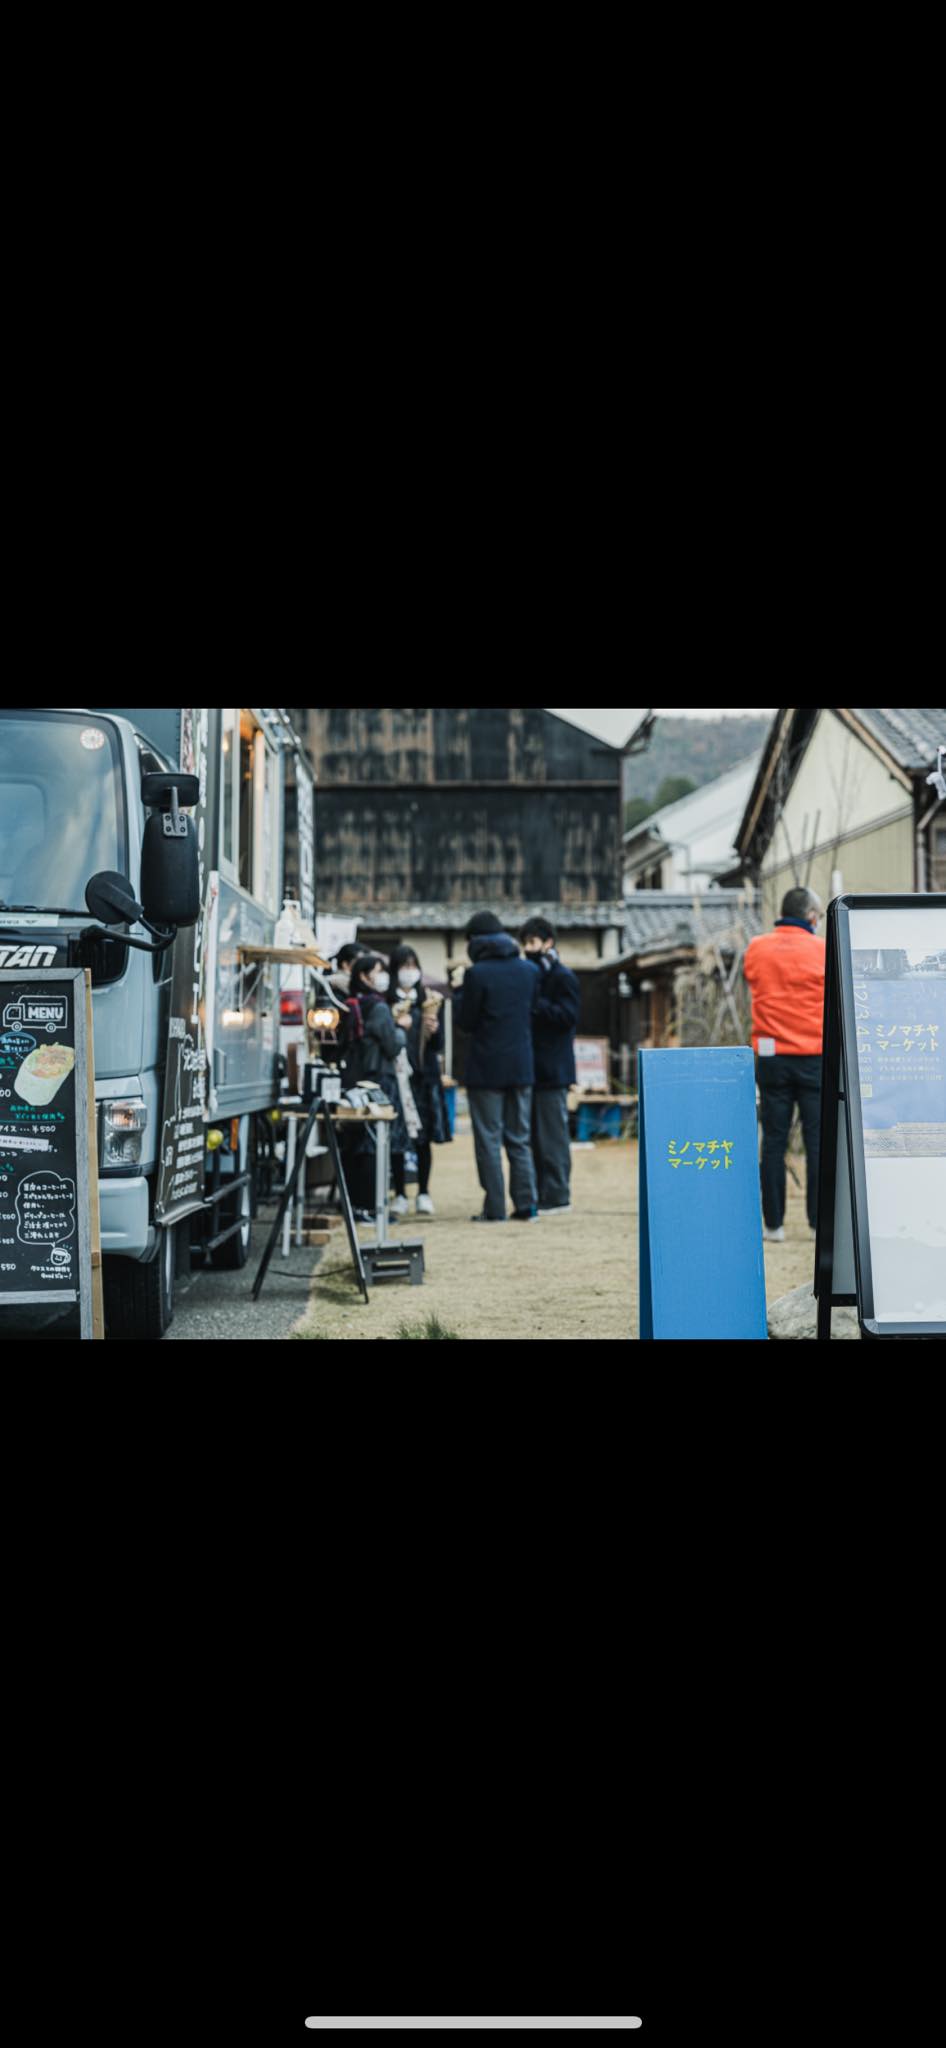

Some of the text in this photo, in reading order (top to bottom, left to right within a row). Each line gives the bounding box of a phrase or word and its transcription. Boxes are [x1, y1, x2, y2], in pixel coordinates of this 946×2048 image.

[28, 1007, 64, 1019] MENU
[875, 1024, 939, 1037] ミノマチヤ
[876, 1038, 939, 1051] マーケット
[668, 1140, 734, 1155] ミノマチヤ
[667, 1155, 733, 1169] マーケット
